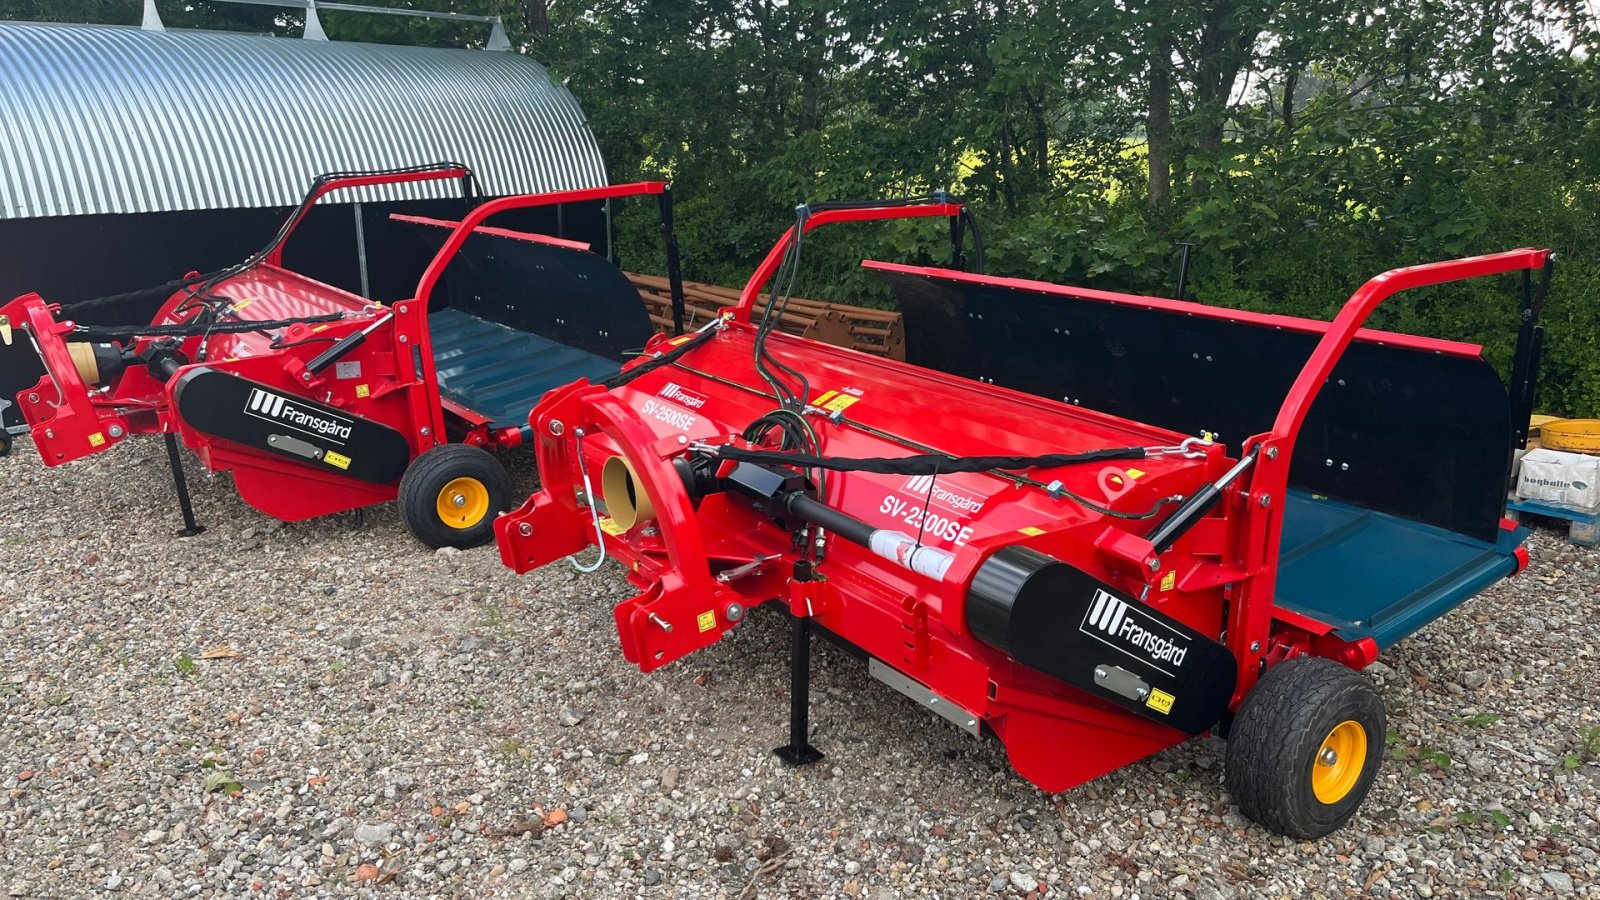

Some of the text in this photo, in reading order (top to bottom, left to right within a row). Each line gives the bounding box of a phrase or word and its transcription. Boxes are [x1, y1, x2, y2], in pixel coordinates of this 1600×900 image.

[281, 405, 352, 439] Fransgård
[641, 400, 696, 431] SV-2500SE
[930, 484, 985, 513] Fransgård
[879, 495, 975, 547] SV-2500SE
[1118, 616, 1188, 667] Fransgård
